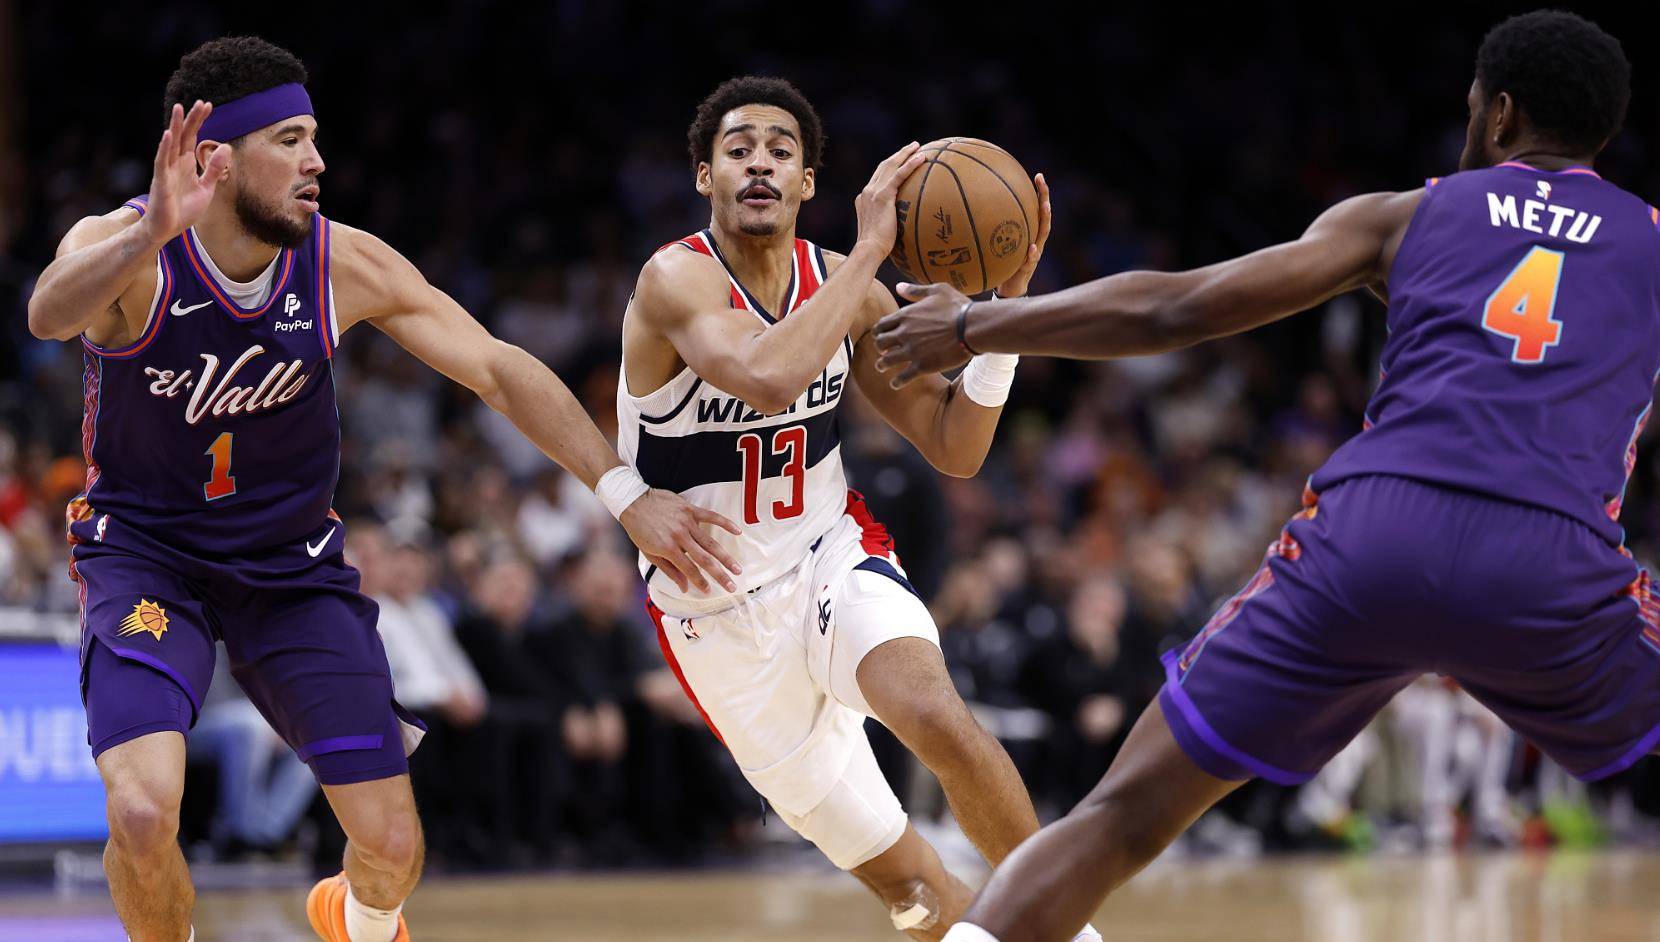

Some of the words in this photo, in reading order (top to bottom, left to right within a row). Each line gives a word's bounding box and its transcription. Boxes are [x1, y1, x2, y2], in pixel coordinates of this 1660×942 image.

[1487, 192, 1602, 243] METU
[274, 319, 313, 333] PayPal
[1481, 244, 1565, 364] 4
[144, 366, 191, 398] El
[185, 344, 309, 425] Valle
[697, 366, 844, 424] wids
[203, 432, 236, 502] 1
[736, 425, 808, 526] 13
